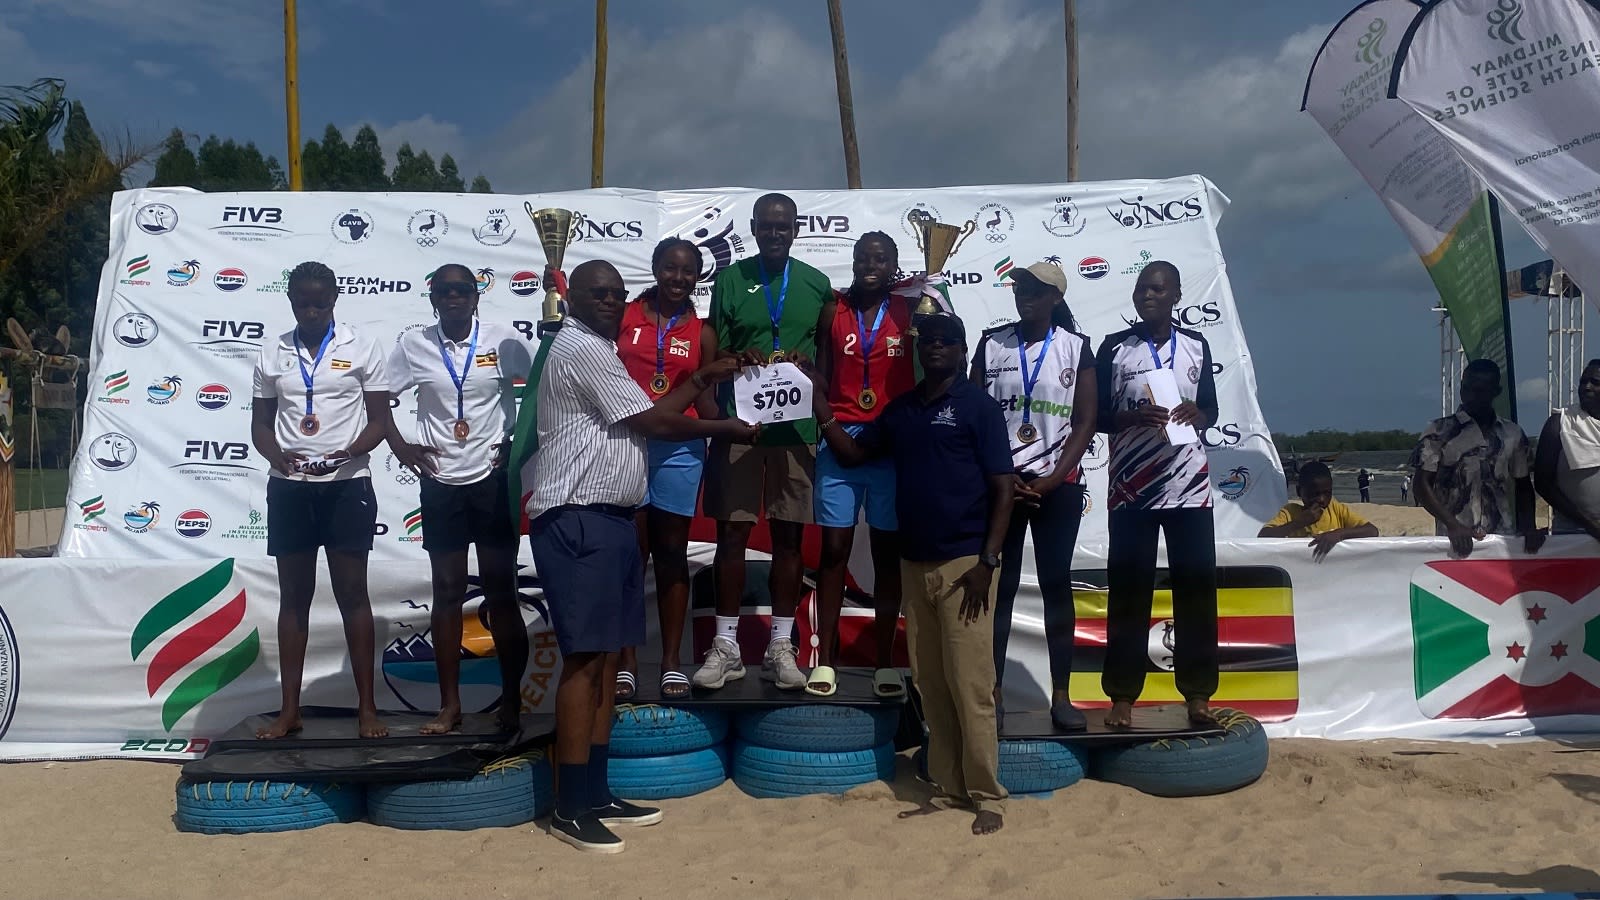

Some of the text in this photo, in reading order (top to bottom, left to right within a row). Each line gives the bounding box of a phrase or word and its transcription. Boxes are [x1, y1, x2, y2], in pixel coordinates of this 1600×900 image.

[223, 206, 283, 223] FIVB
[1141, 197, 1202, 226] NCS
[584, 219, 643, 238] NCS
[1080, 264, 1108, 272] PEPSI
[216, 275, 245, 283] PEPSI
[511, 280, 539, 288] PEPSI
[952, 272, 983, 285] HD
[337, 286, 379, 295] EDIA
[379, 280, 412, 293] HD
[203, 320, 265, 339] FIVB
[632, 327, 642, 345] 1
[843, 333, 857, 356] 2
[669, 346, 689, 358] BDI
[199, 392, 229, 401] PEPSI
[753, 387, 802, 411] $700
[1199, 422, 1241, 447] CS
[184, 440, 249, 460] FIVB
[73, 523, 107, 532] ecopetro
[178, 520, 209, 528] PEPSI
